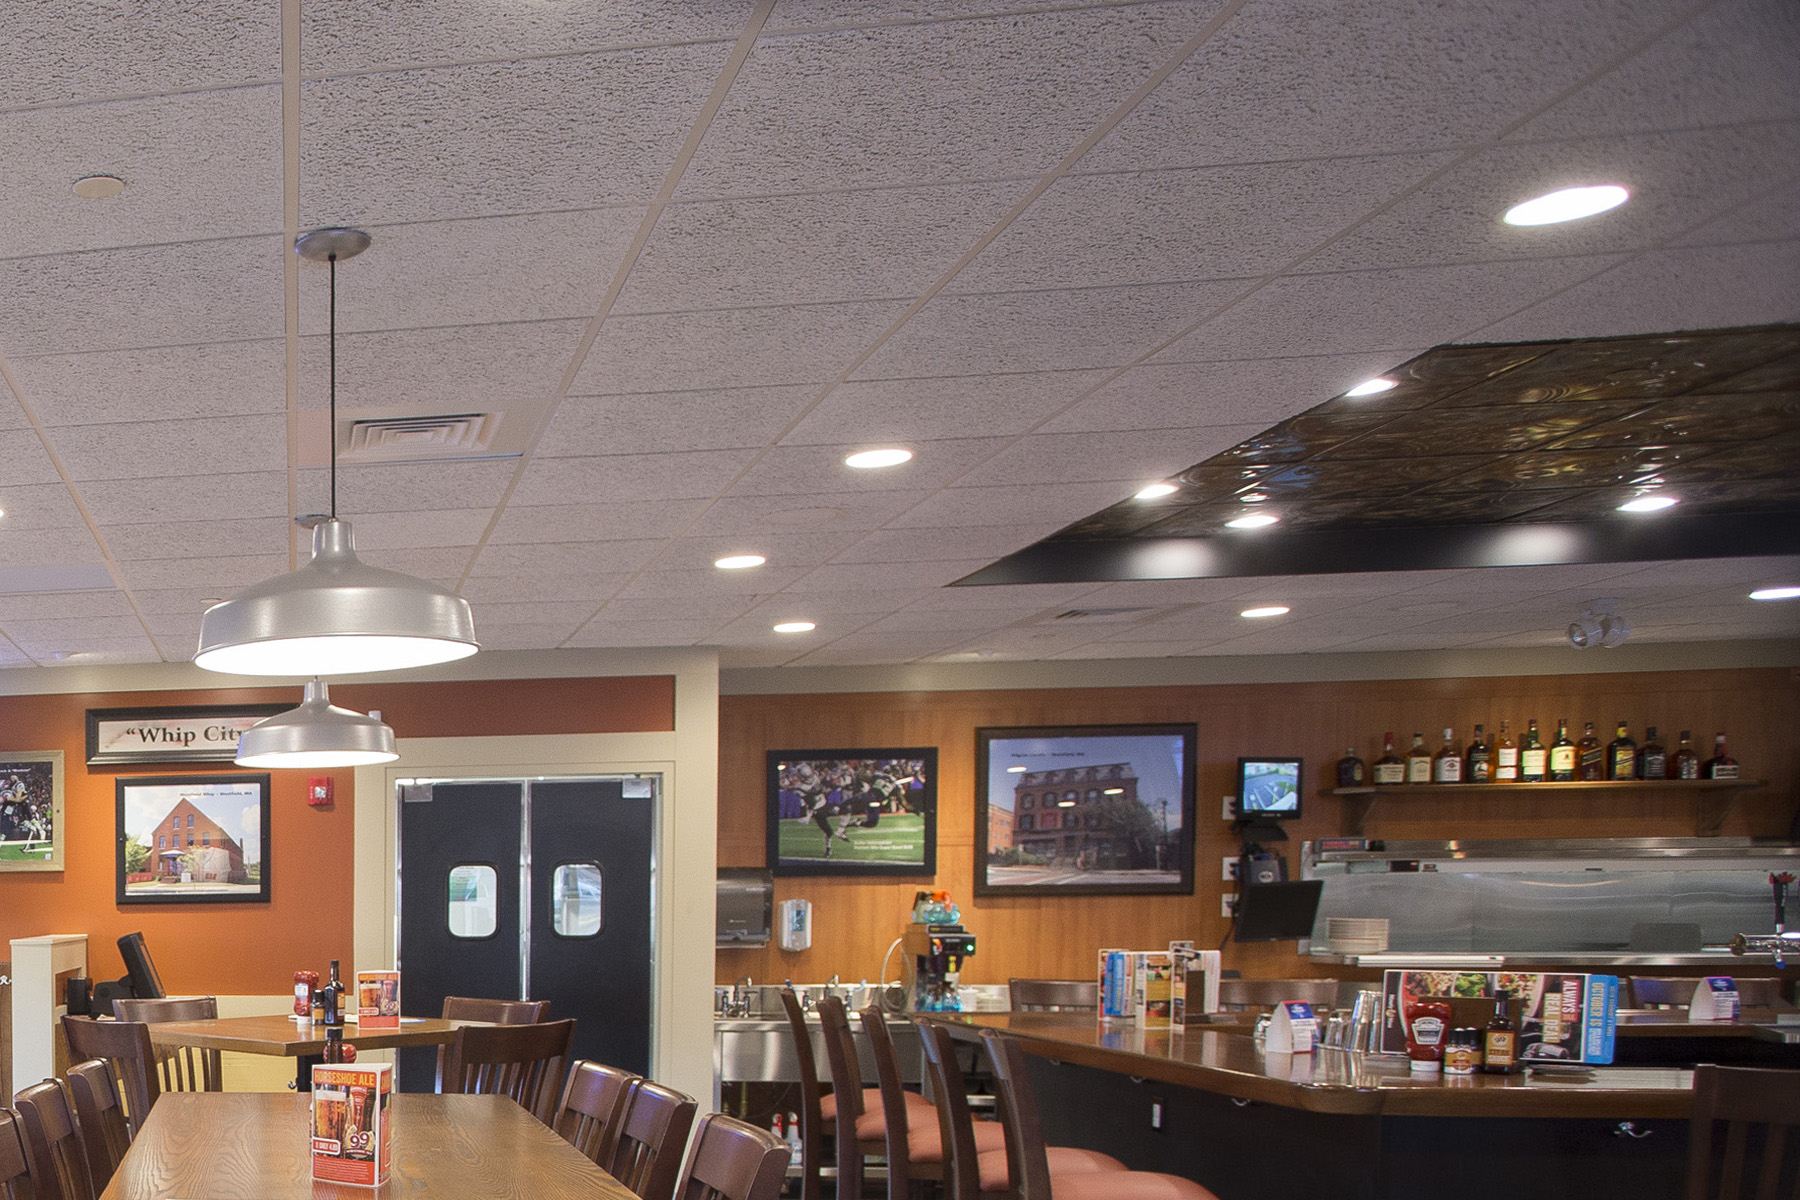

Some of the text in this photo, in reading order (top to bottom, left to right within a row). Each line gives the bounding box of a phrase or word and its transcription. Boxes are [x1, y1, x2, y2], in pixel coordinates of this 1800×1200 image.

[1545, 993, 1560, 1017] REAL
[1561, 980, 1578, 1014] ALWAYS
[359, 1074, 375, 1086] ALE
[349, 1131, 370, 1147] 99
